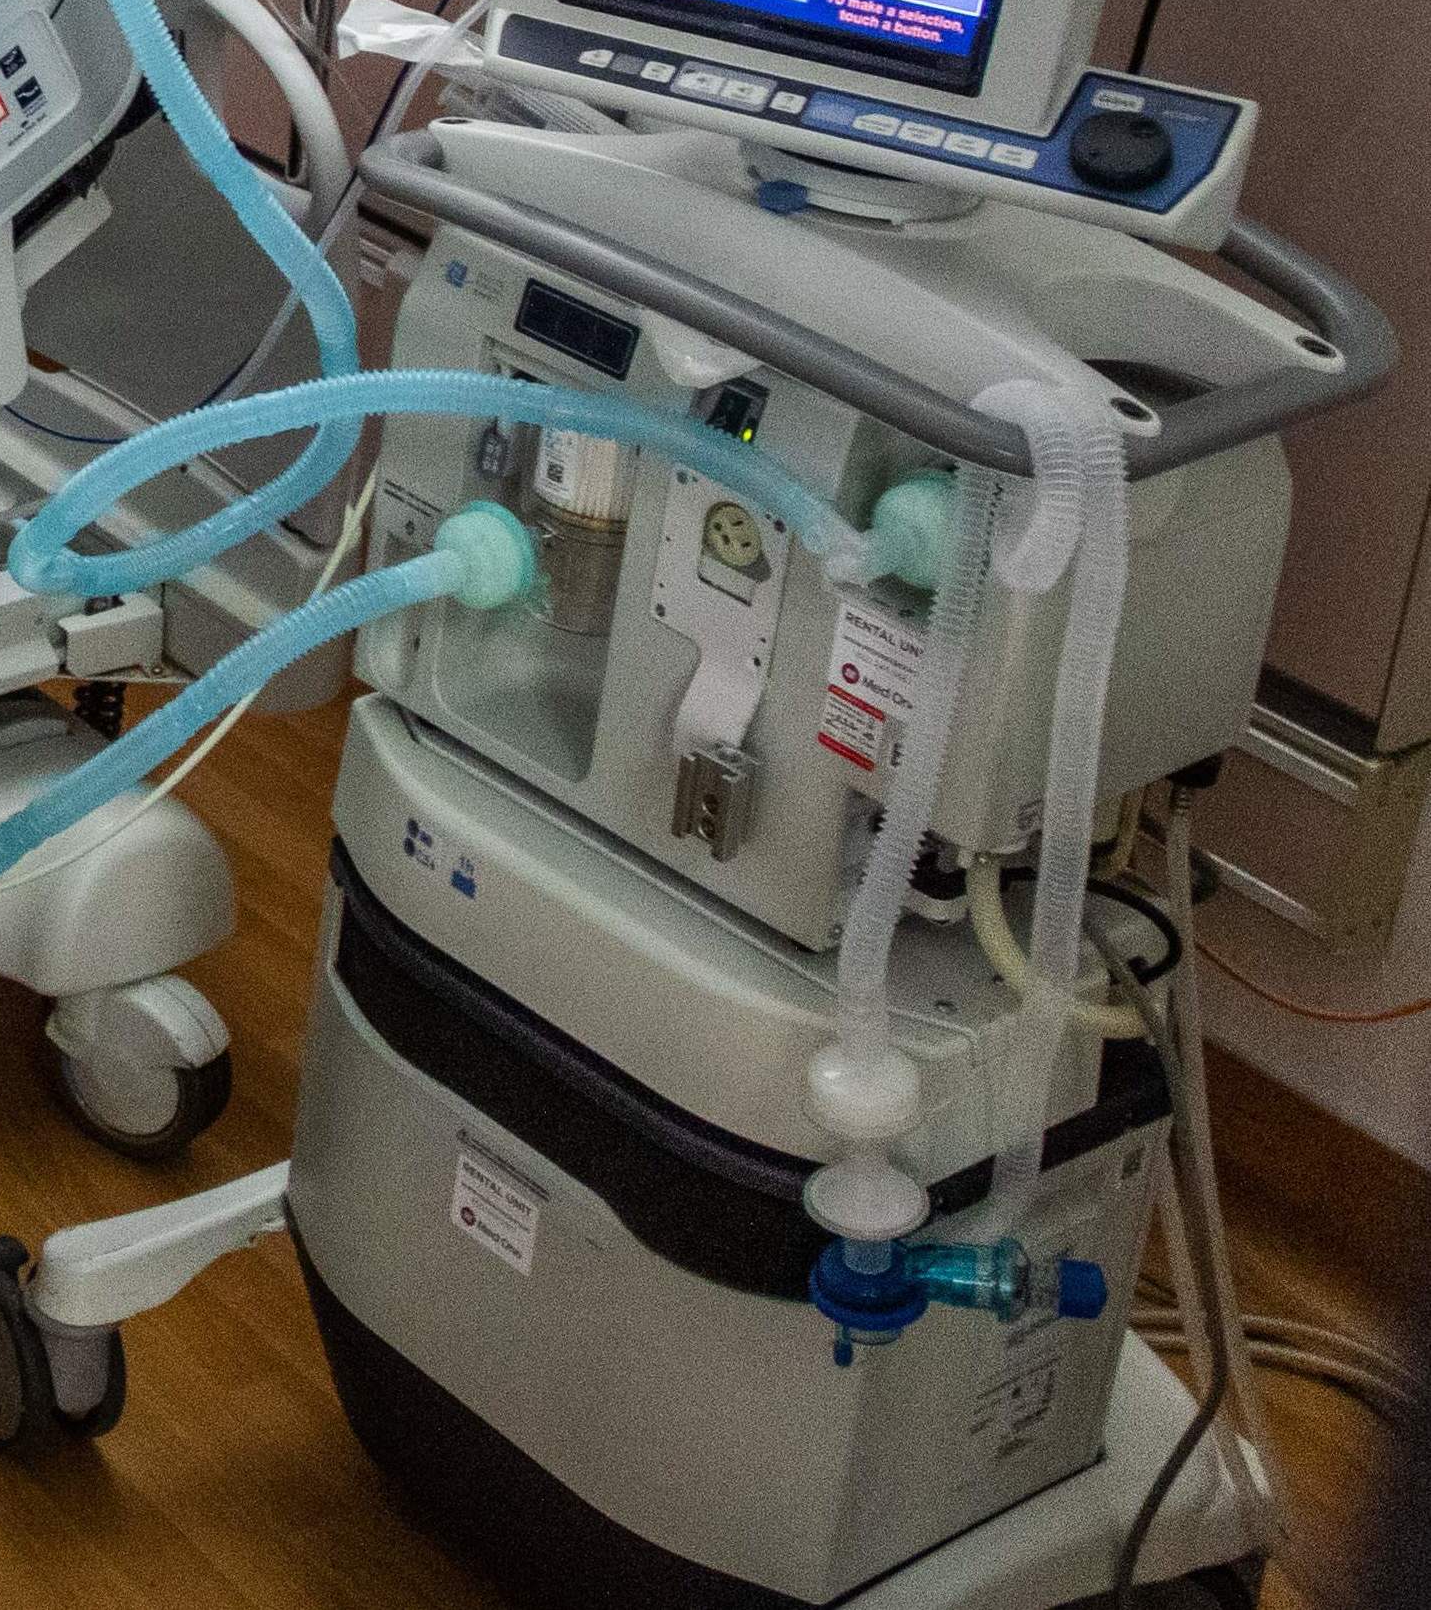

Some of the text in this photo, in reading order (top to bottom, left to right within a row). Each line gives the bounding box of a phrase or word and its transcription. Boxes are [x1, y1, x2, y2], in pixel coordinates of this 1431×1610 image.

[838, 8, 944, 43] touch a button.
[885, 6, 896, 17] a
[897, 8, 965, 34] selection,
[845, 611, 896, 647] RENTAL
[861, 676, 914, 710] Med On
[462, 1160, 504, 1198] RENTAL
[505, 1193, 532, 1217] UNIT
